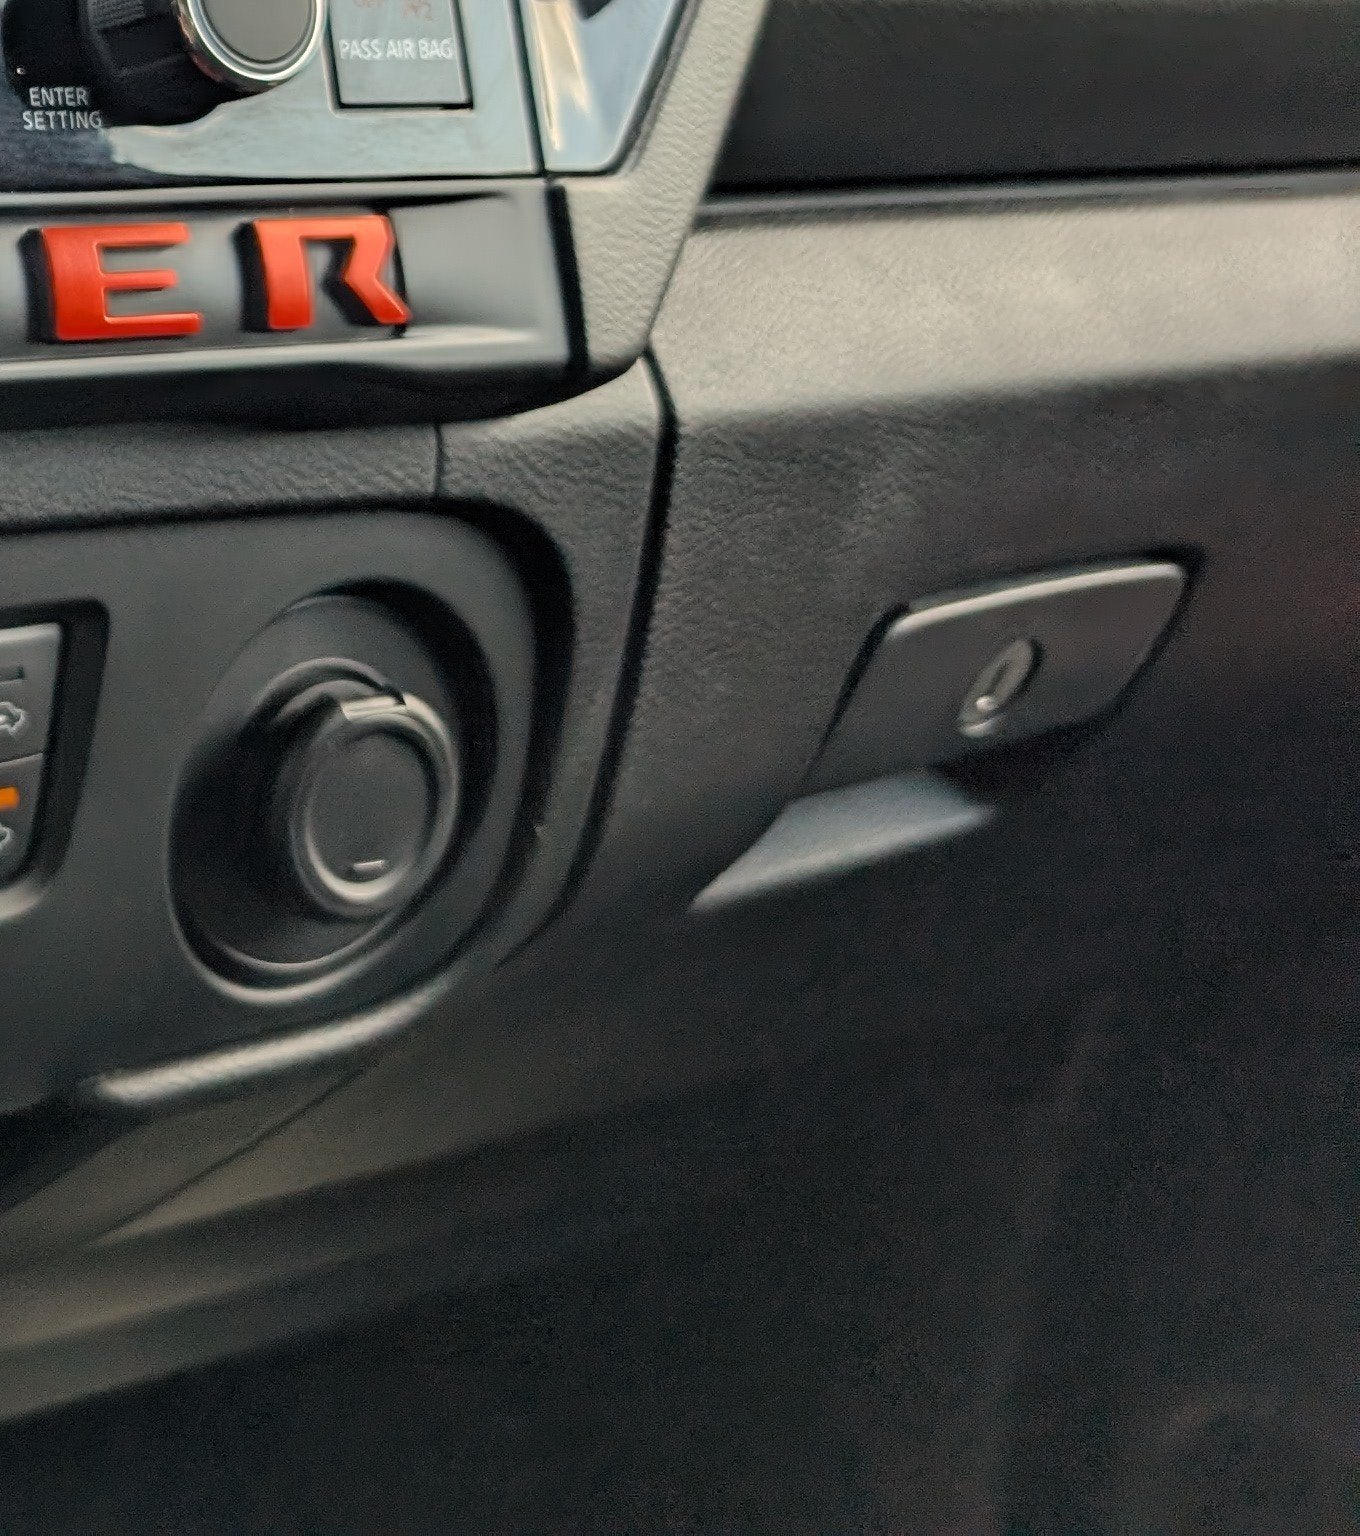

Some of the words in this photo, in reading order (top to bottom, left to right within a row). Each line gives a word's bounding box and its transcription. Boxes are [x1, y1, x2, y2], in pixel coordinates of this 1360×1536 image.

[338, 37, 382, 60] PASS
[385, 37, 417, 59] AIR
[417, 37, 455, 60] BAG
[29, 86, 89, 109] ENTER
[21, 109, 103, 132] SETTING
